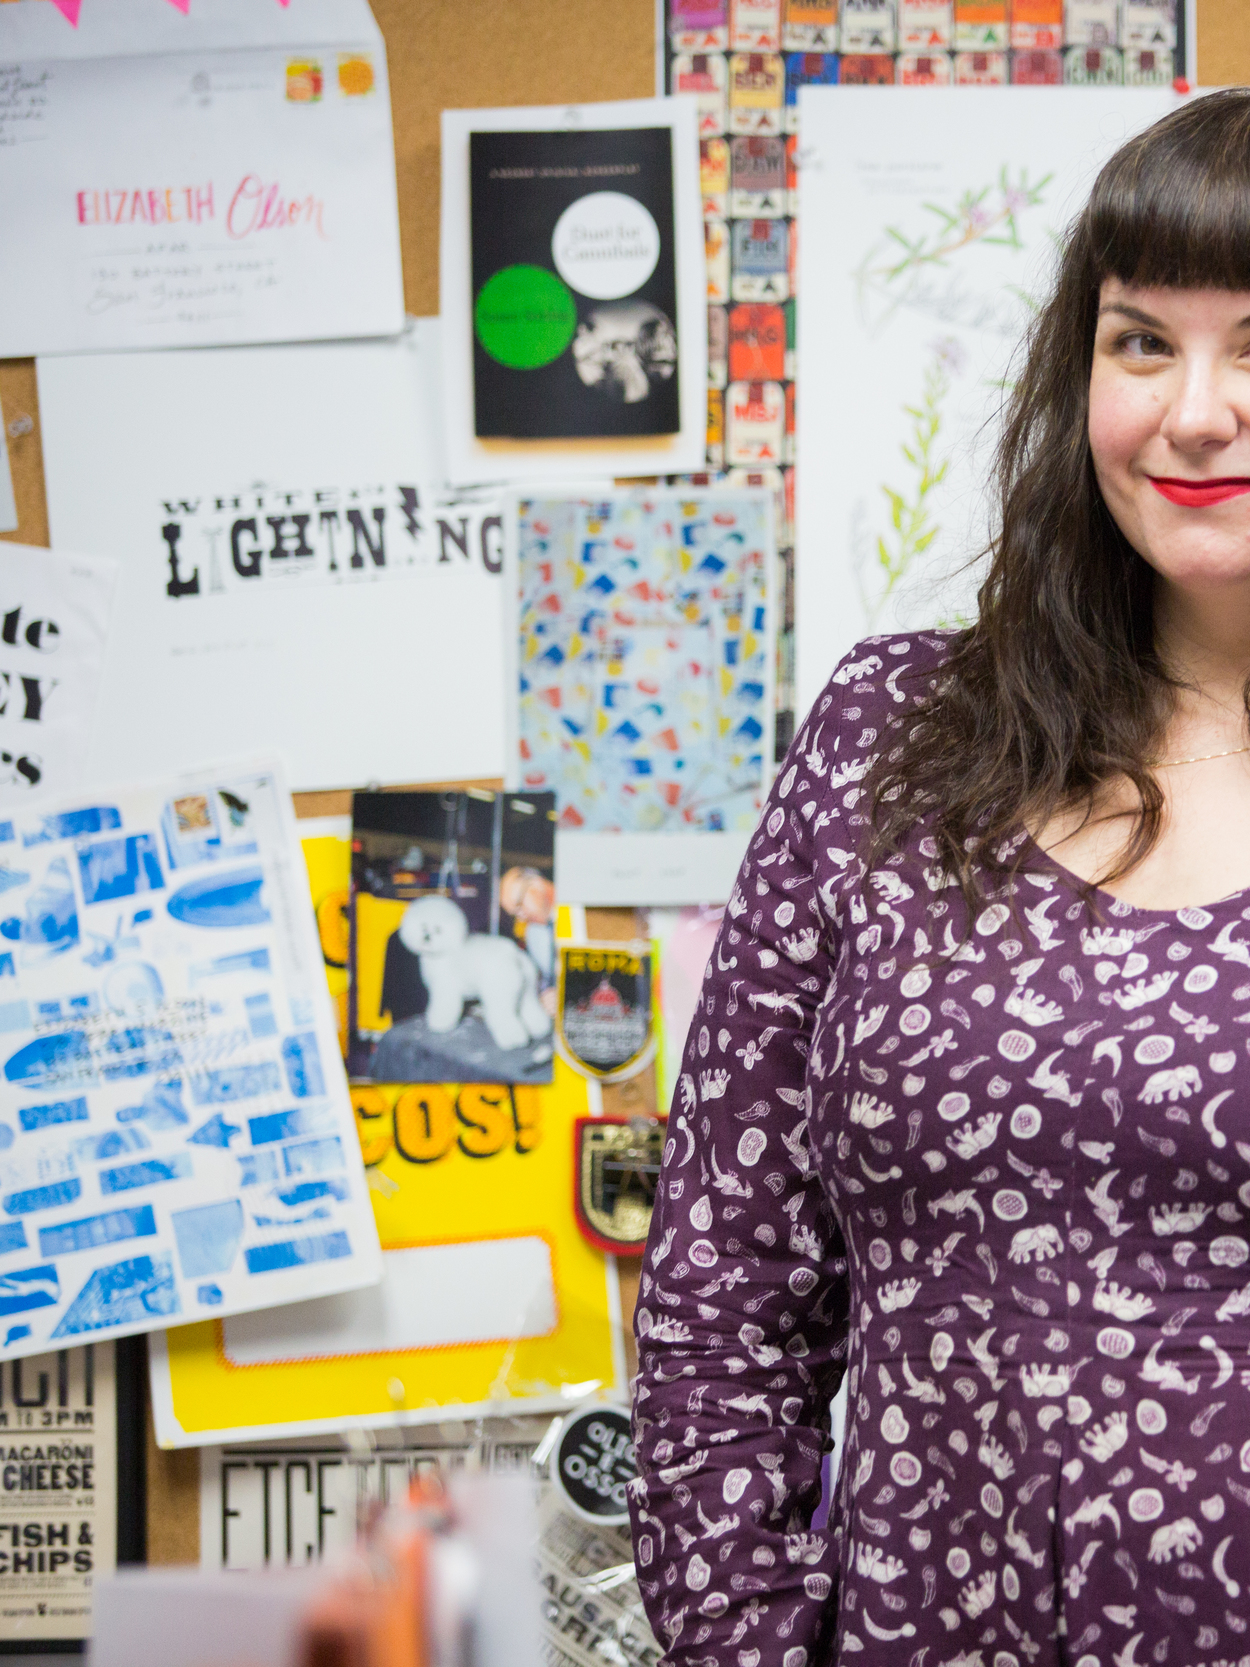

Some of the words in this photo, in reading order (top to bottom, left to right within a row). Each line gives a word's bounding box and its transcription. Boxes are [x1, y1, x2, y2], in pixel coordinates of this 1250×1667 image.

[77, 181, 215, 226] ELIZABETH
[226, 172, 333, 242] Olson
[3, 1464, 94, 1491] CHEESE
[564, 1455, 630, 1506] OSSO
